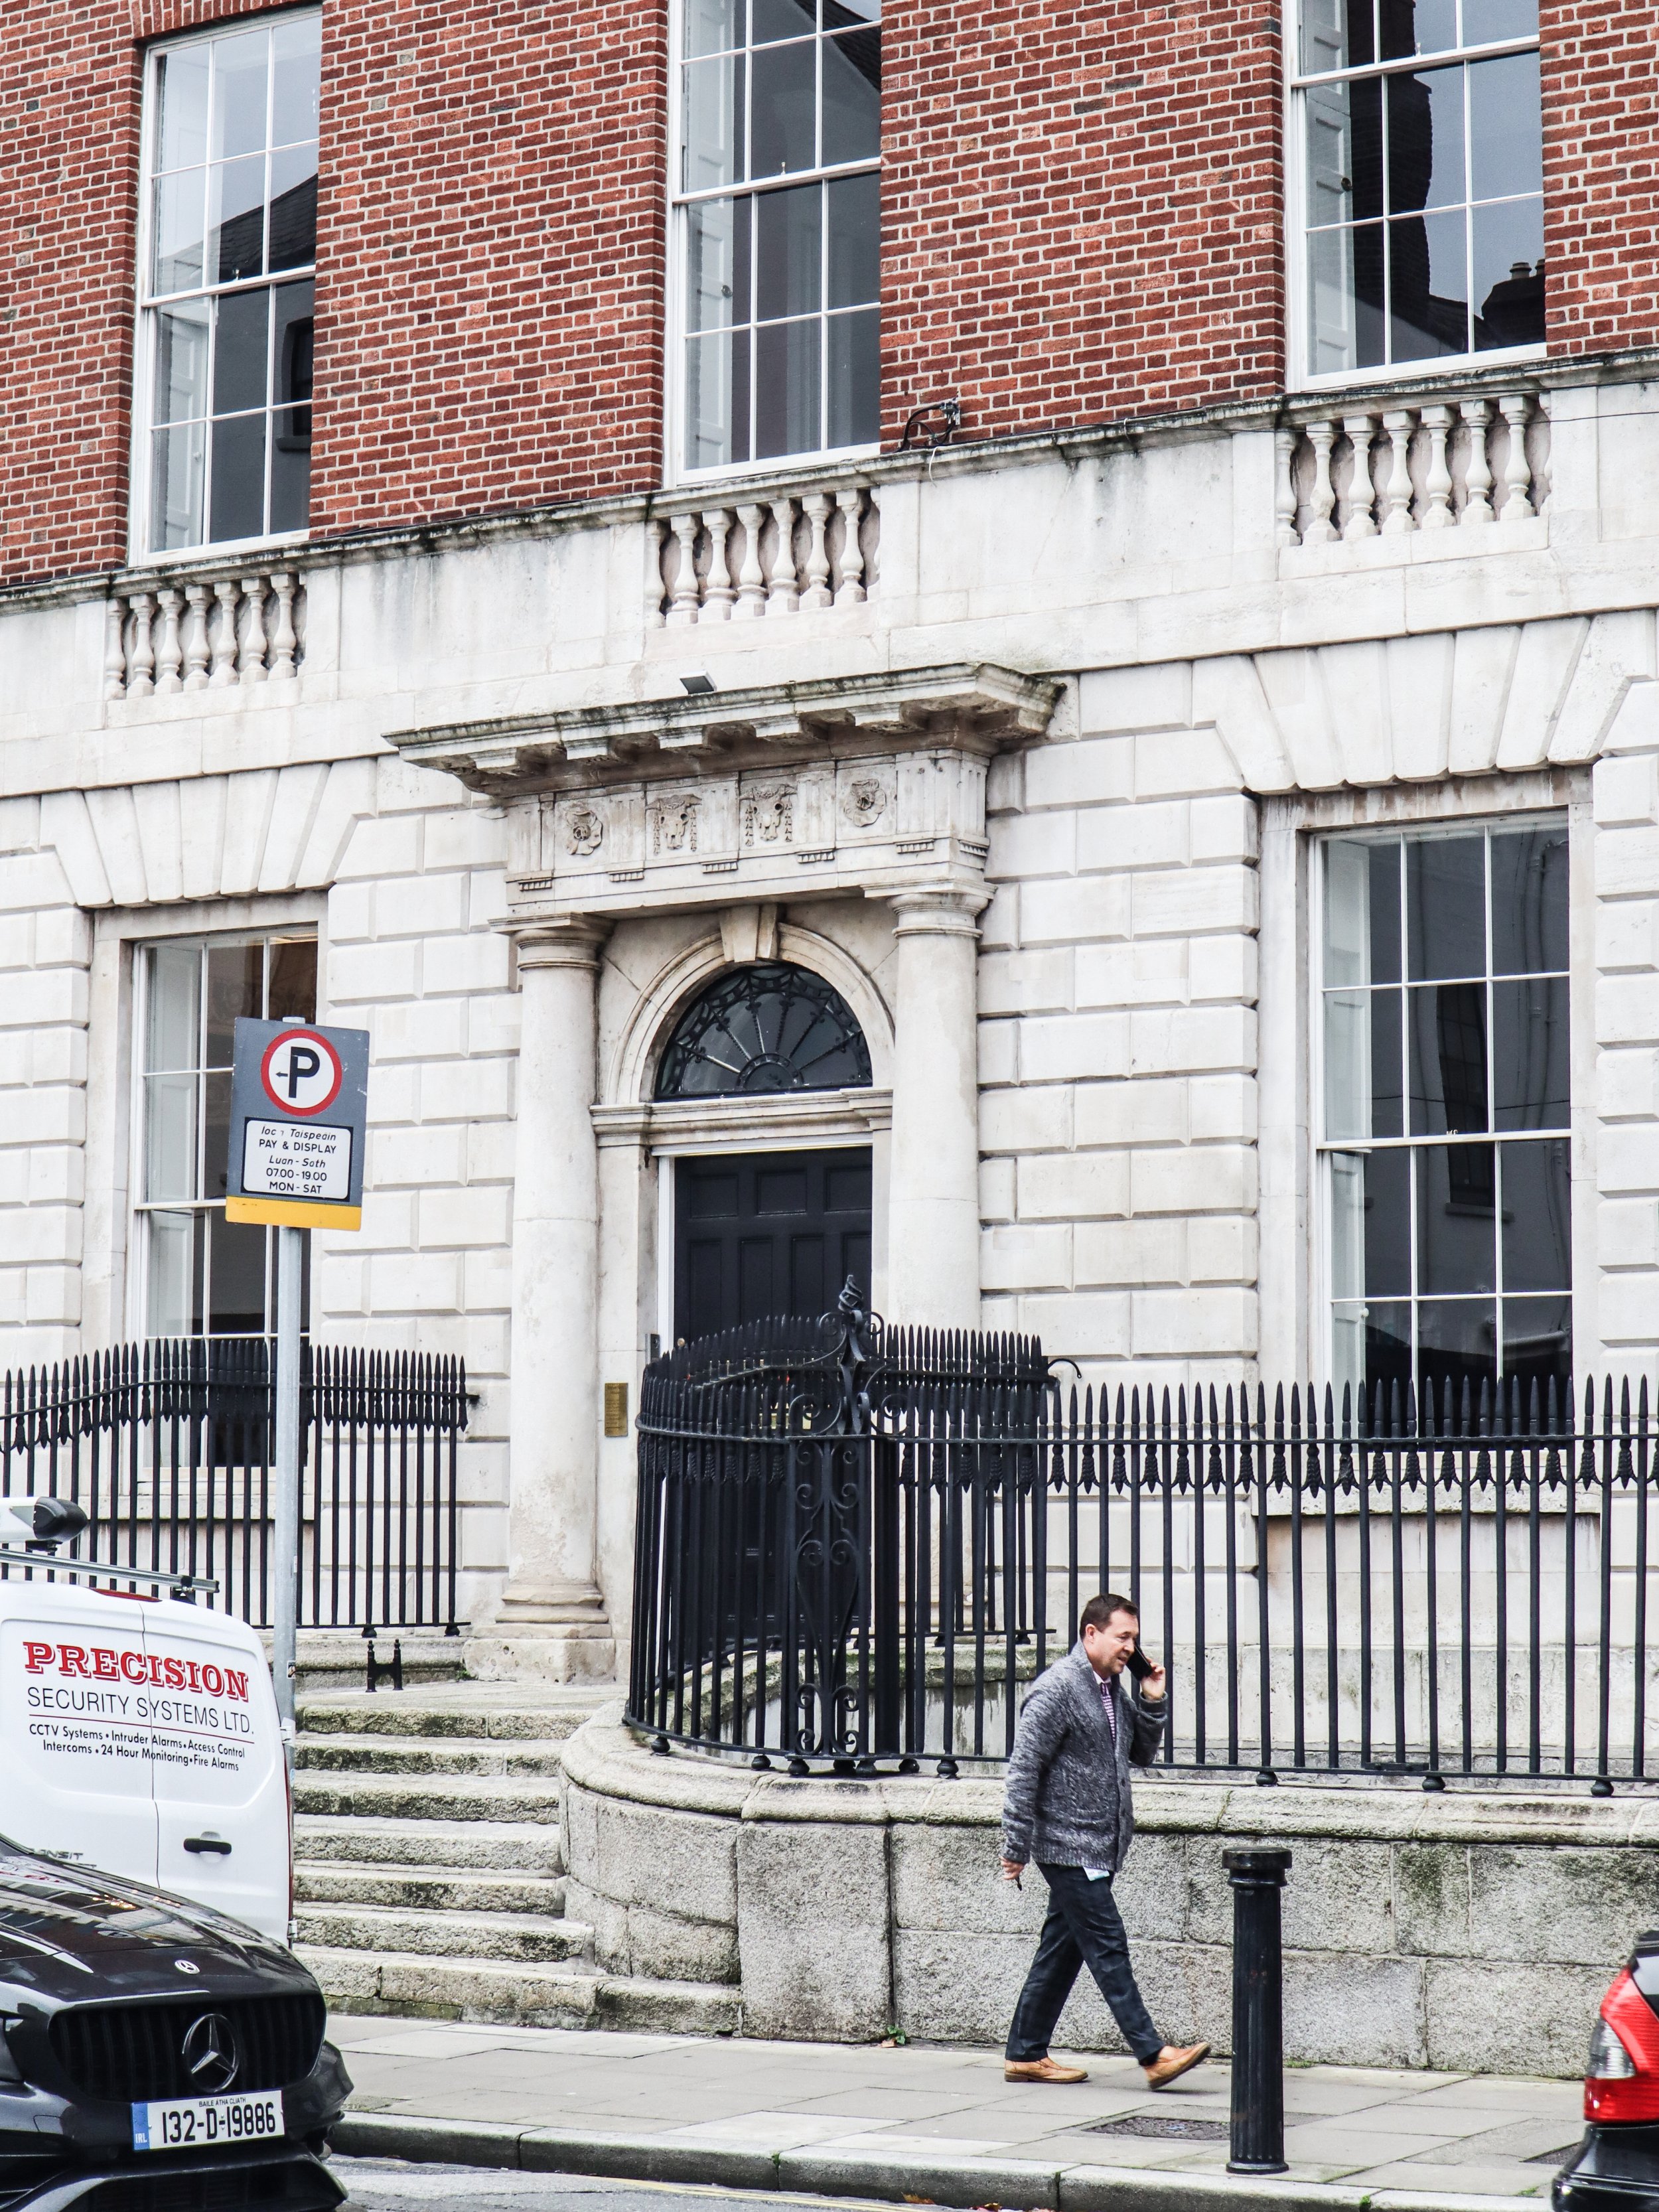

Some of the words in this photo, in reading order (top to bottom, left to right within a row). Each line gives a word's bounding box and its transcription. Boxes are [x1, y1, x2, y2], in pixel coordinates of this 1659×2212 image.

[288, 1046, 320, 1098] P
[259, 1139, 277, 1148] PAY
[282, 1141, 289, 1149] &
[294, 1142, 336, 1153] DISPLAY
[269, 1155, 293, 1165] Luan
[269, 1181, 294, 1191] MON
[303, 1184, 322, 1194] SAT
[23, 1641, 249, 1702] PRECISION
[28, 1686, 129, 1715] SECURITY
[137, 1698, 219, 1728] SYSTEMS
[224, 1711, 255, 1734] LTD.
[29, 1724, 58, 1736] CCTV
[63, 1726, 103, 1741] Systems
[111, 1730, 149, 1745] Intruder
[152, 1734, 186, 1749] Alarms
[188, 1739, 216, 1753] Access
[218, 1743, 245, 1758] Control
[43, 1739, 92, 1754] Intercoms
[101, 1744, 113, 1755] 24
[117, 1745, 139, 1758] Hour
[142, 1748, 189, 1766] Monitoring
[194, 1754, 208, 1767] Fire
[212, 1757, 239, 1771] Alarms
[135, 2132, 147, 2144] IRL
[162, 2102, 275, 2144] 132-D-19886
